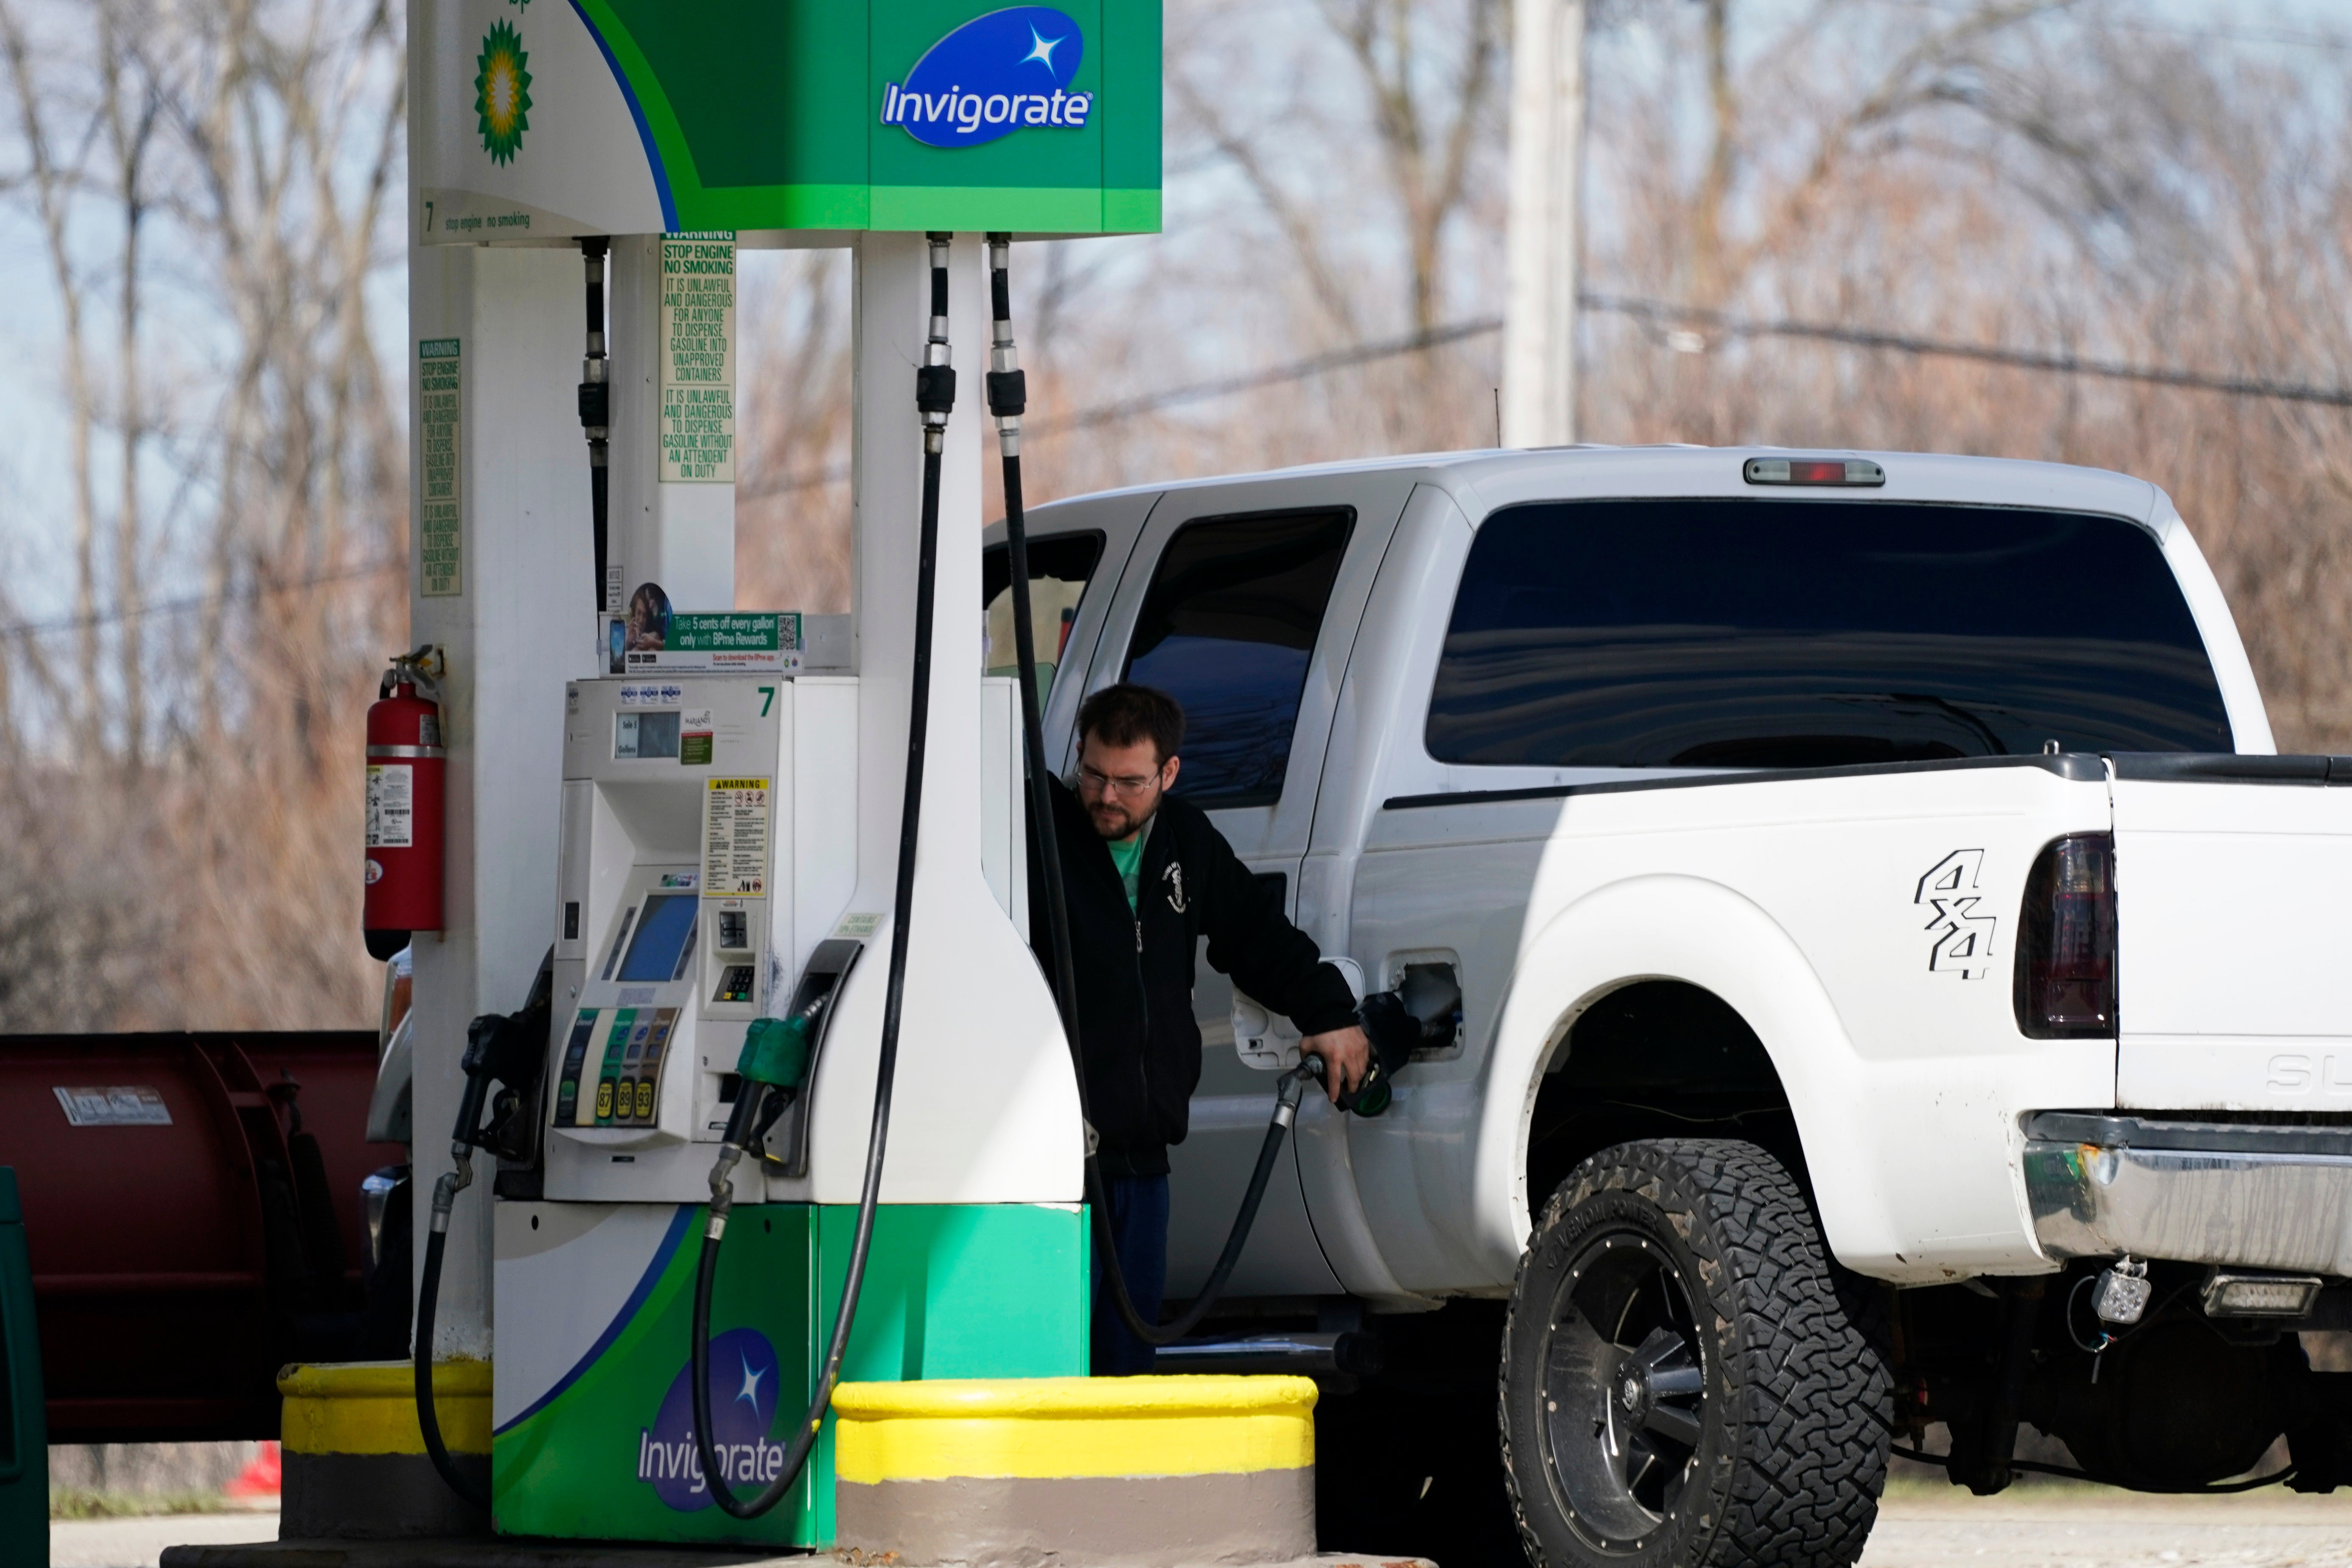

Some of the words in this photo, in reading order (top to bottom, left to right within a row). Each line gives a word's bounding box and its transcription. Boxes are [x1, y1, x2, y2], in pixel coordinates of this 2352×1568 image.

[885, 84, 1089, 133] Invigorate
[426, 201, 433, 232] 7
[445, 218, 459, 233] stop
[460, 213, 482, 232] engine
[487, 215, 496, 227] no
[498, 211, 530, 229] smoking
[664, 245, 692, 258] STOP
[694, 245, 733, 259] ENGINE
[664, 260, 681, 274] NO
[683, 260, 733, 274] SMOKING
[666, 278, 674, 292] IT
[677, 278, 684, 292] IS
[687, 278, 730, 293] UNLAWFUL
[664, 293, 683, 307] AND
[685, 293, 732, 307] DANGEROUS
[674, 308, 689, 321] FOR
[692, 308, 724, 322] ANYONE
[672, 323, 682, 336] TO
[685, 323, 723, 337] DISPENSE
[422, 342, 457, 357] WARNING
[670, 338, 708, 352] GASOLINE
[710, 338, 727, 352] INTO
[673, 352, 724, 366] UNAPPROVED
[422, 362, 436, 376] STOP
[437, 361, 458, 375] ENGINE
[676, 367, 722, 381] CONTAINERS
[423, 377, 430, 392] NO
[431, 376, 458, 391] SMOKING
[666, 389, 674, 403] IT
[677, 389, 684, 403] IS
[687, 390, 730, 404] UNLAWFUL
[664, 405, 681, 418] AND
[685, 405, 732, 419] DANGEROUS
[672, 419, 682, 433] TO
[685, 420, 722, 433] DISPENSE
[663, 434, 698, 448] GASOLINE
[700, 435, 733, 448] WITHOUT
[669, 450, 680, 463] AN
[683, 450, 728, 463] ATTENDENT
[681, 464, 692, 477] ON
[695, 464, 716, 478] DUTY
[675, 616, 691, 631] Take
[693, 616, 698, 630] 5
[699, 618, 719, 630] cents
[720, 616, 731, 630] off
[731, 620, 752, 632] every
[680, 632, 697, 649] only
[697, 633, 712, 646] with
[713, 632, 735, 646] BPme
[736, 632, 767, 646] Rewards
[758, 687, 774, 717] 7
[618, 745, 636, 754] Gallons
[722, 780, 760, 789] WARNING
[599, 1092, 611, 1107] 87
[620, 1091, 631, 1106] 89
[638, 1092, 650, 1107] 93
